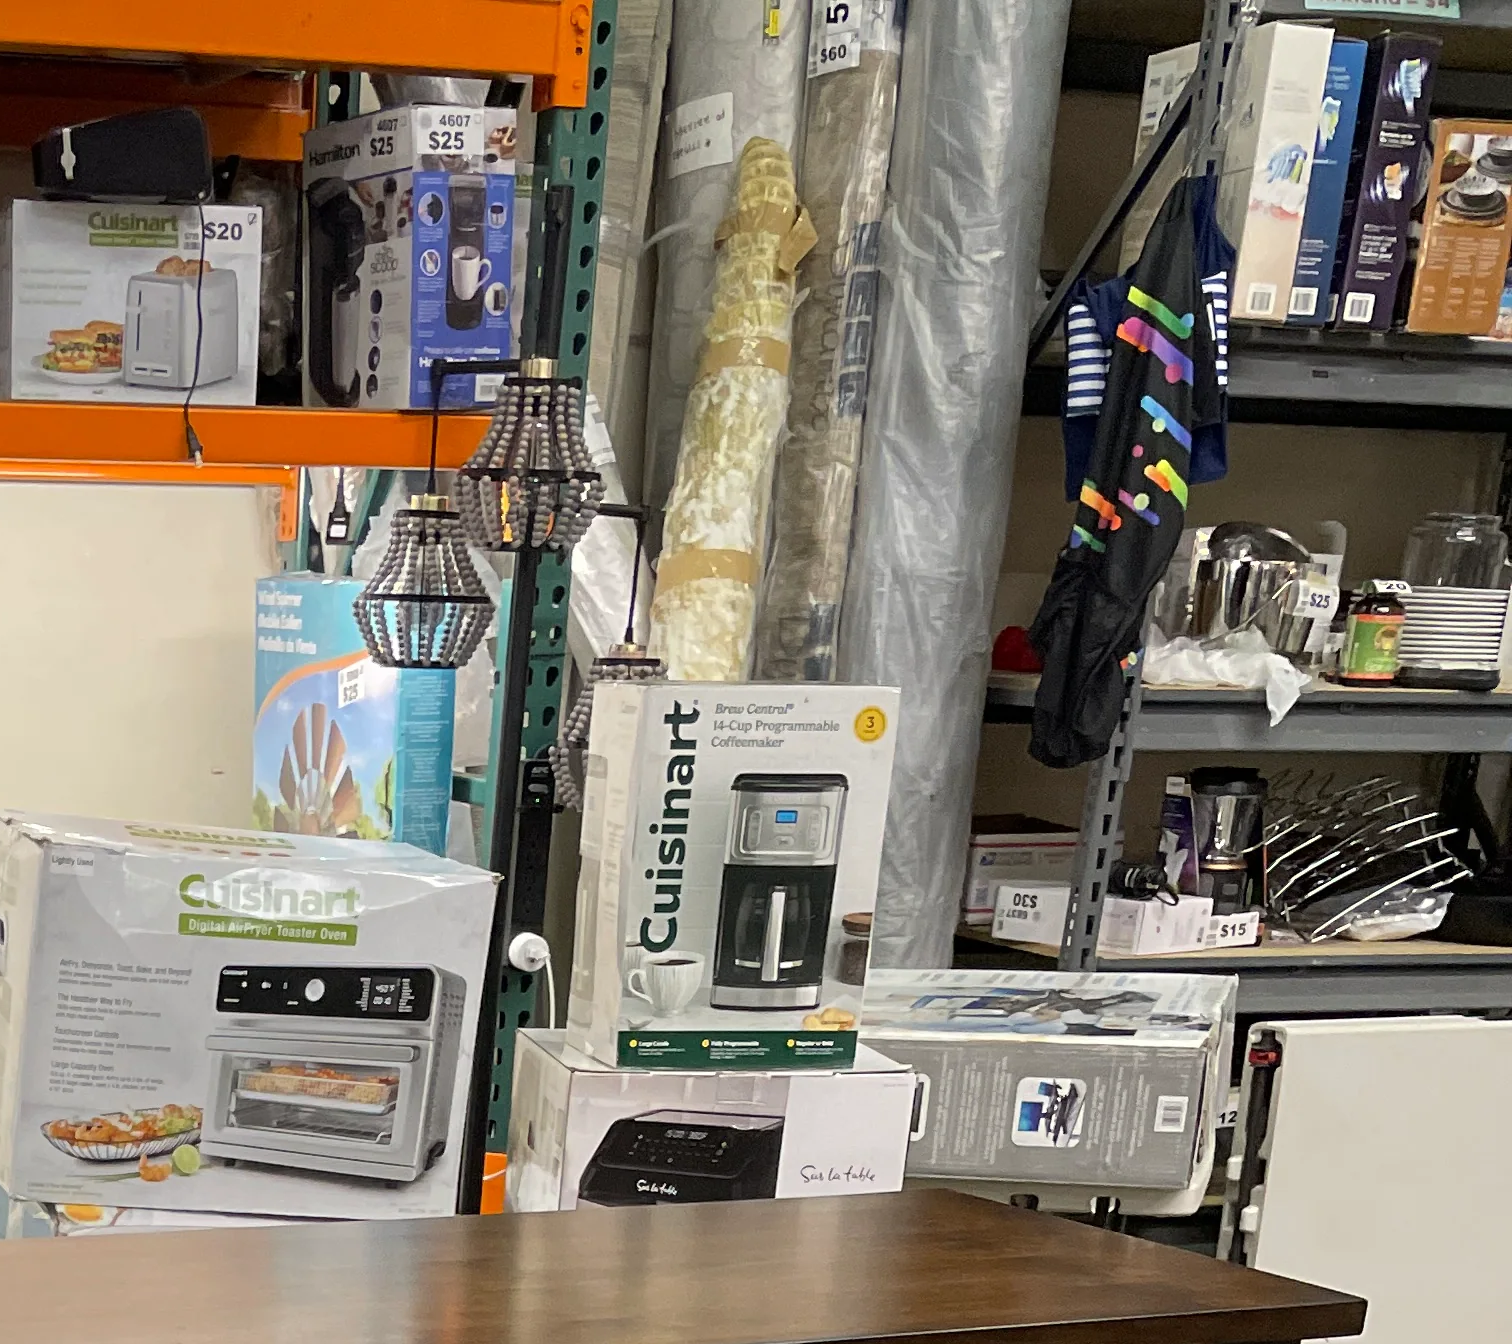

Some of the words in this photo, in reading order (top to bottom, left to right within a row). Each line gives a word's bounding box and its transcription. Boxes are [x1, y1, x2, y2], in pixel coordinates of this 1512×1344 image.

[826, 3, 849, 24] 5
[820, 44, 847, 64] $60
[439, 114, 471, 128] 4607
[369, 135, 394, 158] $25
[428, 131, 465, 151] $25
[308, 142, 361, 168] Hamilton
[88, 211, 180, 232] Cuisinart
[203, 221, 243, 241] $20
[1309, 592, 1331, 609] $25
[714, 703, 745, 715] Brew
[713, 719, 753, 733] 14-Cup
[755, 719, 841, 734] Programmable
[865, 716, 875, 729] 3
[710, 735, 785, 748] Coffeemaker
[639, 699, 700, 953] Cuisinart
[178, 873, 361, 915] Cuisinart
[1012, 892, 1038, 910] $30
[188, 918, 225, 934] Digital
[227, 922, 273, 937] AirFryer
[276, 924, 317, 939] Toaster
[320, 928, 347, 941] Oven
[1219, 922, 1247, 938] $15
[827, 1167, 841, 1180] la
[843, 1165, 876, 1182] table
